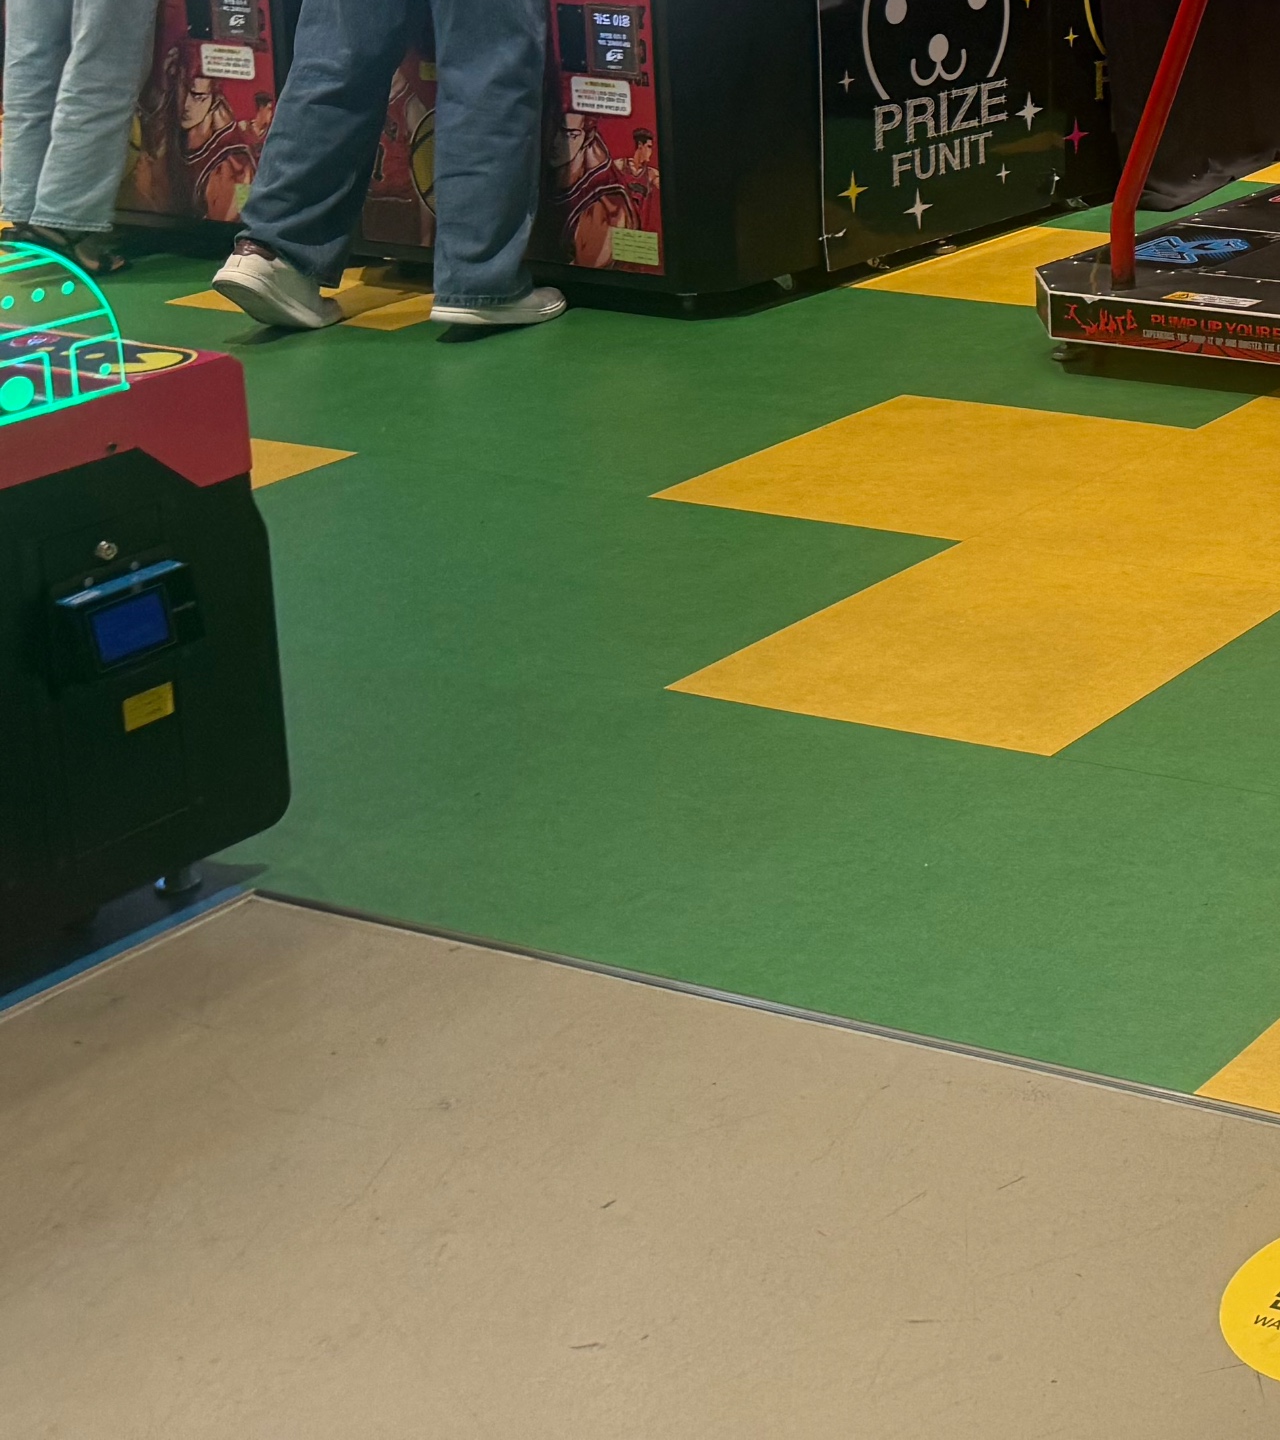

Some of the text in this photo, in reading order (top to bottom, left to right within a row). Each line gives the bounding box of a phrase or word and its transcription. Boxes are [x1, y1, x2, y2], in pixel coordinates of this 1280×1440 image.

[593, 12, 631, 28] 카드 이용
[873, 76, 1009, 151] PRIZE
[892, 130, 994, 187] FUNIT
[1150, 314, 1198, 329] PUMP
[1200, 319, 1223, 332] UP
[1225, 321, 1270, 339] YOUR
